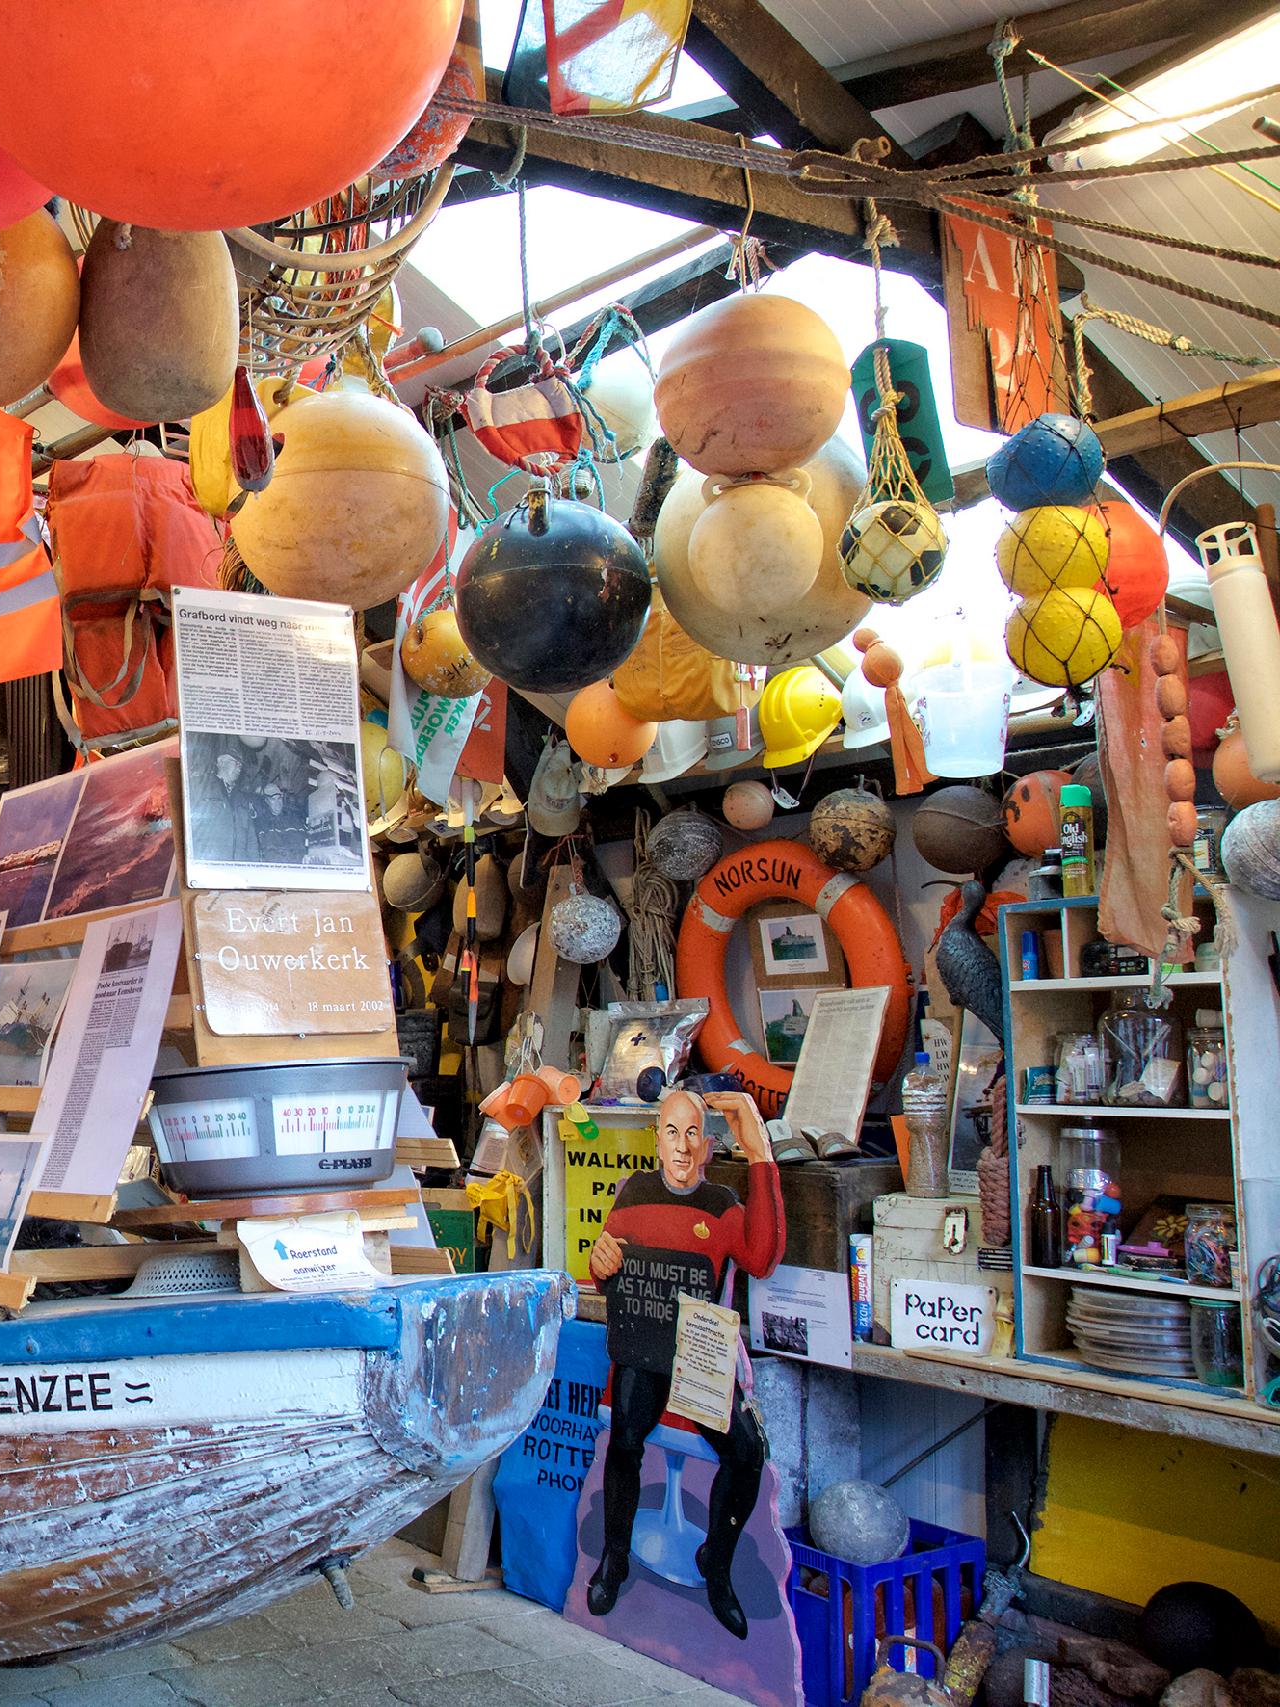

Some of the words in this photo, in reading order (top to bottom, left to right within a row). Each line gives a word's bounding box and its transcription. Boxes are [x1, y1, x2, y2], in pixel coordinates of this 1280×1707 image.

[179, 607, 226, 623] Grafbord
[229, 613, 254, 626] vindt
[257, 618, 278, 630] weg
[280, 620, 302, 631] naar
[1063, 823, 1079, 834] Old
[713, 857, 802, 897] NORSUN
[225, 906, 301, 934] Evert
[312, 909, 354, 938] Jan
[219, 945, 371, 972] Ouwerkerk
[308, 1001, 318, 1012] 18
[322, 1002, 356, 1012] maart
[360, 1000, 384, 1012] 2002
[934, 1038, 948, 1048] HW
[936, 1050, 948, 1060] LW
[192, 1116, 196, 1124] 0
[215, 1114, 223, 1122] 20
[228, 1113, 236, 1121] 30
[282, 1108, 291, 1117] 40
[294, 1108, 302, 1116] 30
[308, 1108, 316, 1116] 20
[322, 1107, 328, 1116] 10
[337, 1106, 342, 1114] 0
[348, 1106, 354, 1114] 10
[568, 1151, 654, 1170] WALKIN
[580, 1208, 602, 1223] IN
[290, 1244, 338, 1260] Roerstand
[578, 1239, 596, 1253] P
[294, 1263, 336, 1276] aanwijzer
[622, 1258, 645, 1277] YOU
[650, 1262, 686, 1282] MUST
[690, 1268, 708, 1286] BE
[616, 1276, 634, 1295] AS
[636, 1279, 666, 1301] TALL
[624, 1297, 640, 1315] TO
[644, 1301, 674, 1321] RIDE
[860, 1302, 868, 1327] HDX2
[916, 1322, 979, 1346] card
[523, 1435, 595, 1468] ROTTE
